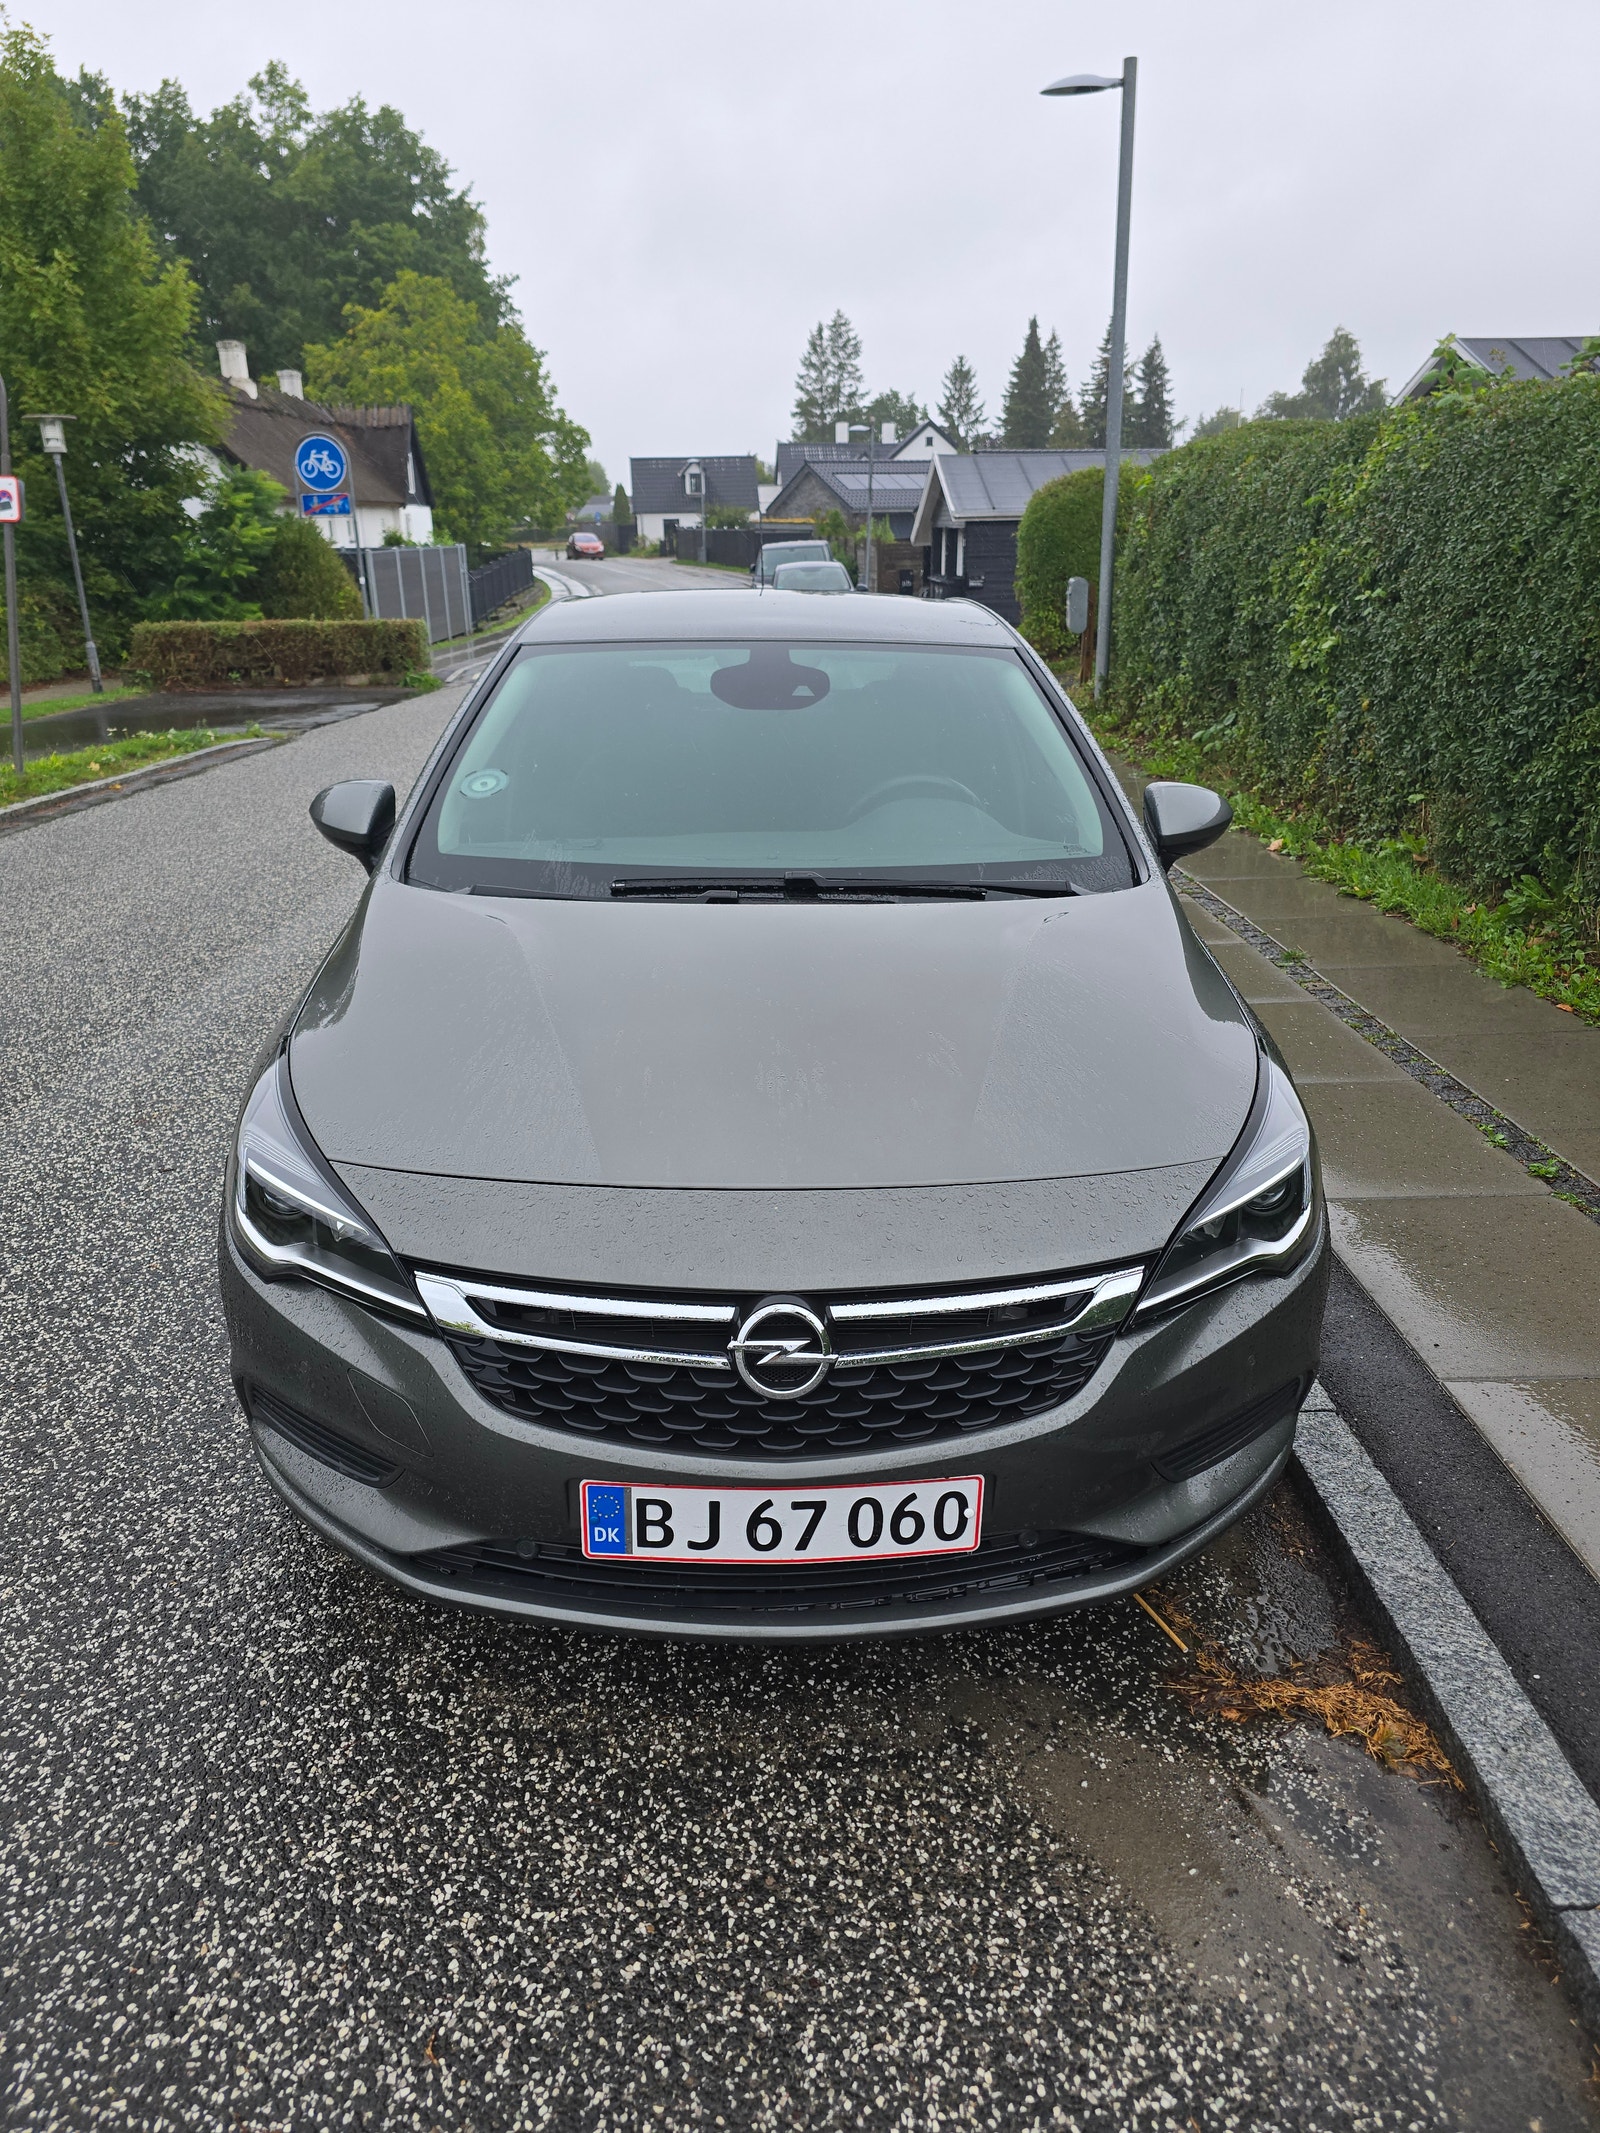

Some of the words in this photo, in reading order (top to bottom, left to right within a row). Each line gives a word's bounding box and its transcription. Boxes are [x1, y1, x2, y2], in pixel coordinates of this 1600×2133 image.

[594, 1526, 620, 1543] DK
[636, 1498, 721, 1551] BJ
[746, 1498, 827, 1552] 67
[847, 1491, 969, 1549] 060
